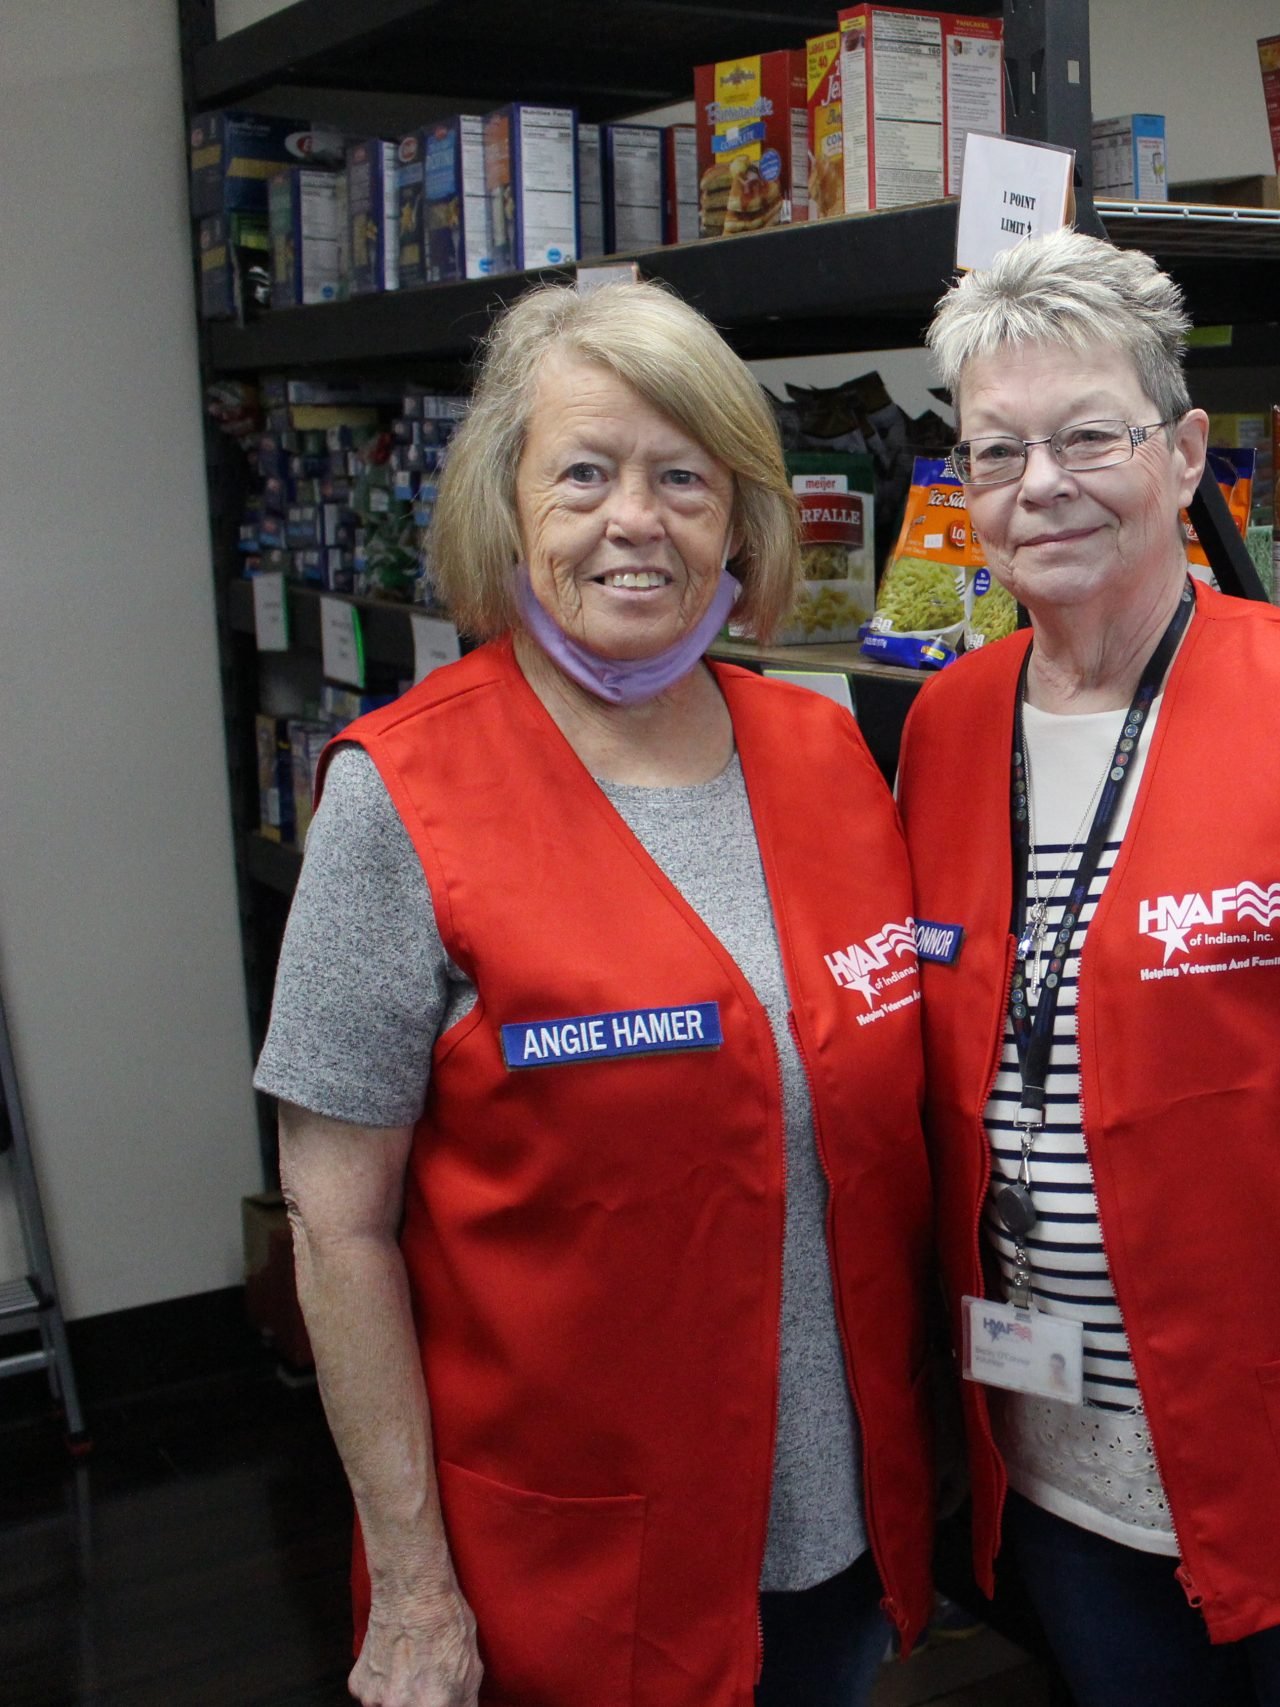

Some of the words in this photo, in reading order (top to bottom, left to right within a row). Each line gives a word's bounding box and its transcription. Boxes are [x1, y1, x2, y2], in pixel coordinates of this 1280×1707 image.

[1009, 193, 1036, 210] POINT
[1001, 217, 1026, 235] LIMIT
[806, 477, 836, 491] meijer
[1138, 888, 1237, 934] HVAF
[1189, 933, 1202, 946] of
[1204, 932, 1250, 946] Indiana,
[1253, 931, 1274, 943] Inc.
[823, 932, 893, 986] HVAF
[1140, 967, 1179, 981] Helping
[1180, 963, 1228, 975] Veterans
[1228, 958, 1250, 970] And
[875, 977, 884, 990] of
[883, 966, 917, 986] Indiana,
[856, 1006, 885, 1026] Helping
[880, 994, 914, 1013] Veterans
[523, 1020, 608, 1060] ANGIE
[611, 1010, 705, 1048] HAMER
